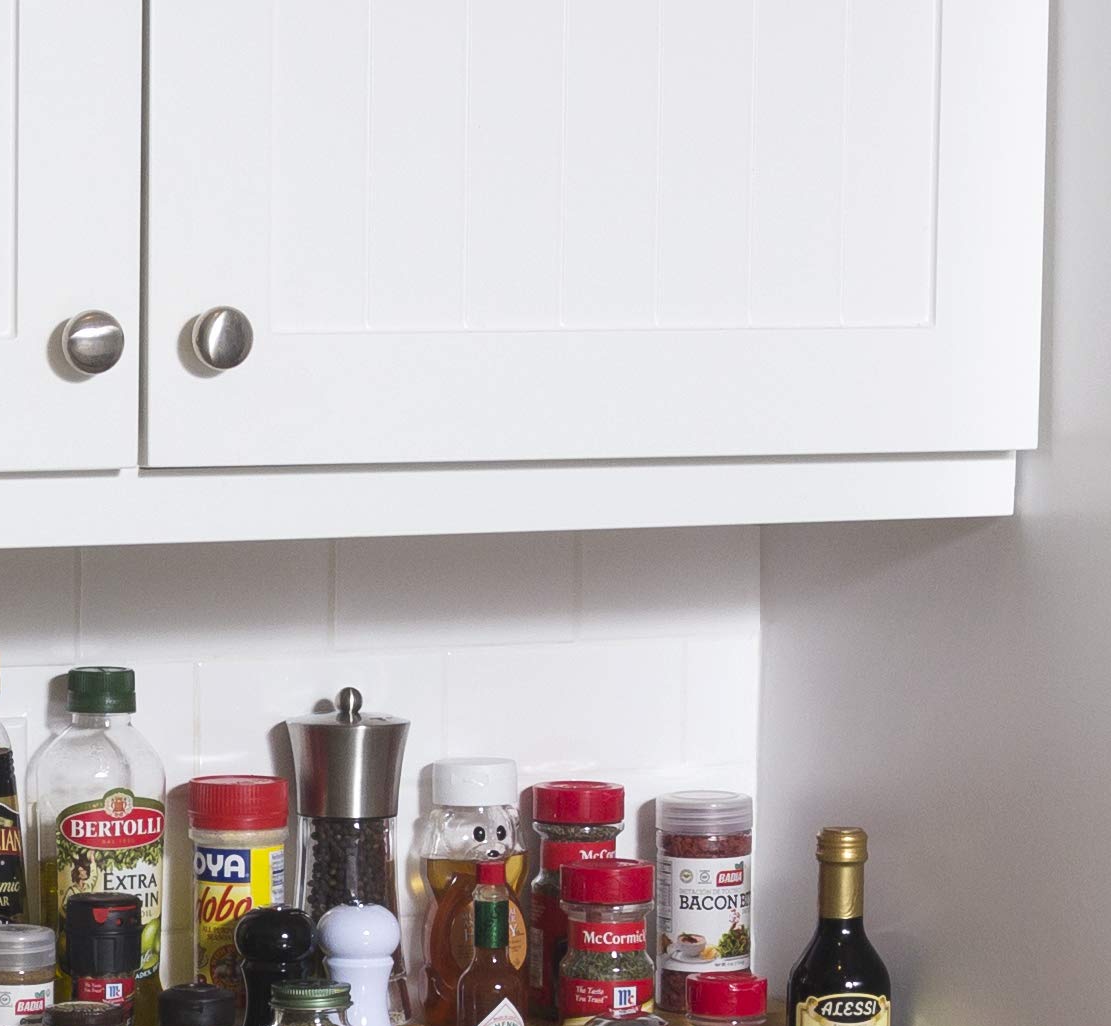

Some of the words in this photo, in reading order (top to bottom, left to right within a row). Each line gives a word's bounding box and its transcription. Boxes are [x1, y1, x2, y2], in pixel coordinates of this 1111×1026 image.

[70, 817, 162, 838] BERTOLLI
[194, 852, 246, 879] OYA
[103, 872, 158, 890] EXTRA
[718, 872, 743, 884] BADIA
[679, 894, 738, 911] BACON
[575, 985, 586, 993] The
[17, 1000, 44, 1013] BADIA
[821, 1001, 878, 1016] ALESSI
